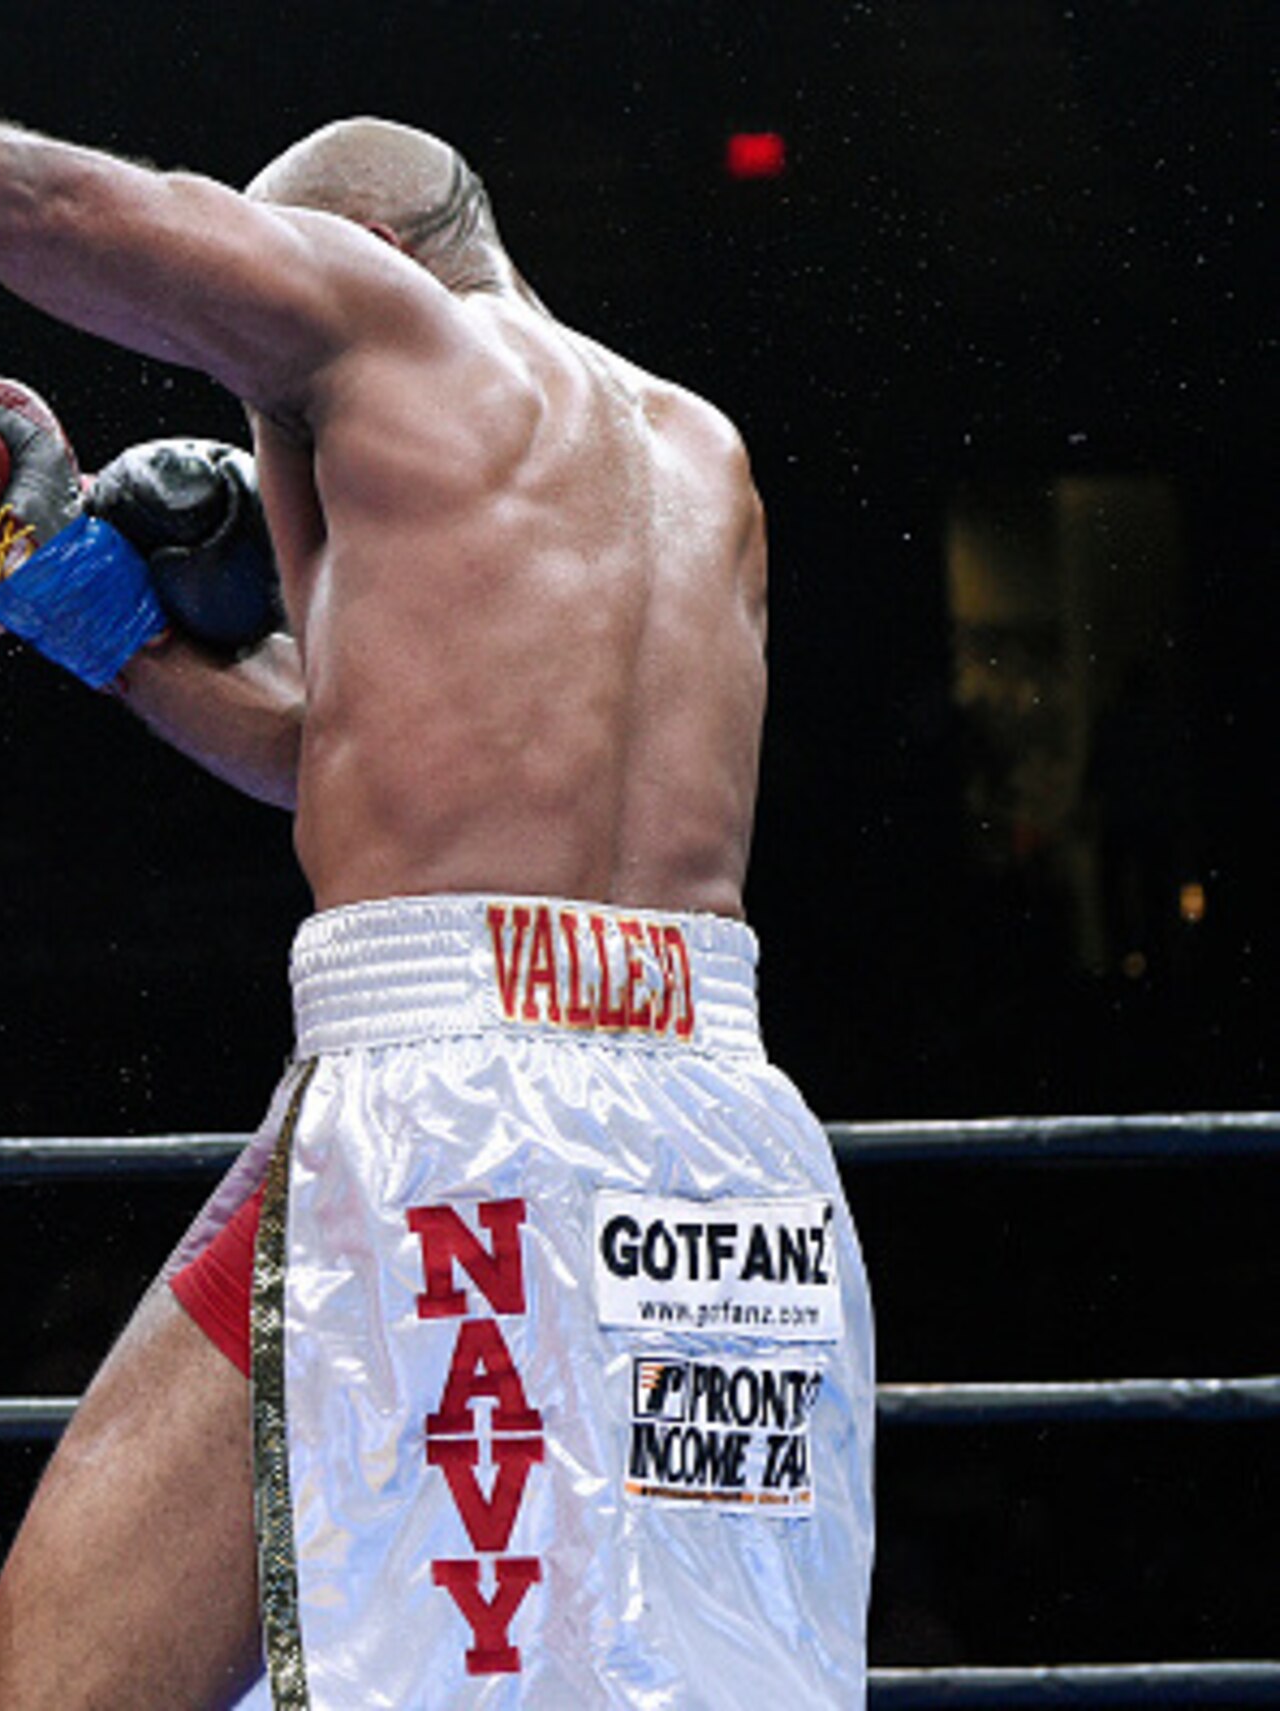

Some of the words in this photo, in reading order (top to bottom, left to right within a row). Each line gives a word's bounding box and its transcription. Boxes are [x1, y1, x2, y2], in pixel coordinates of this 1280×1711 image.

[486, 904, 695, 1042] VALLEJO
[599, 1214, 830, 1286] GOTFANZ
[405, 1197, 545, 1676] NAVY
[628, 1422, 751, 1488] INCOME
